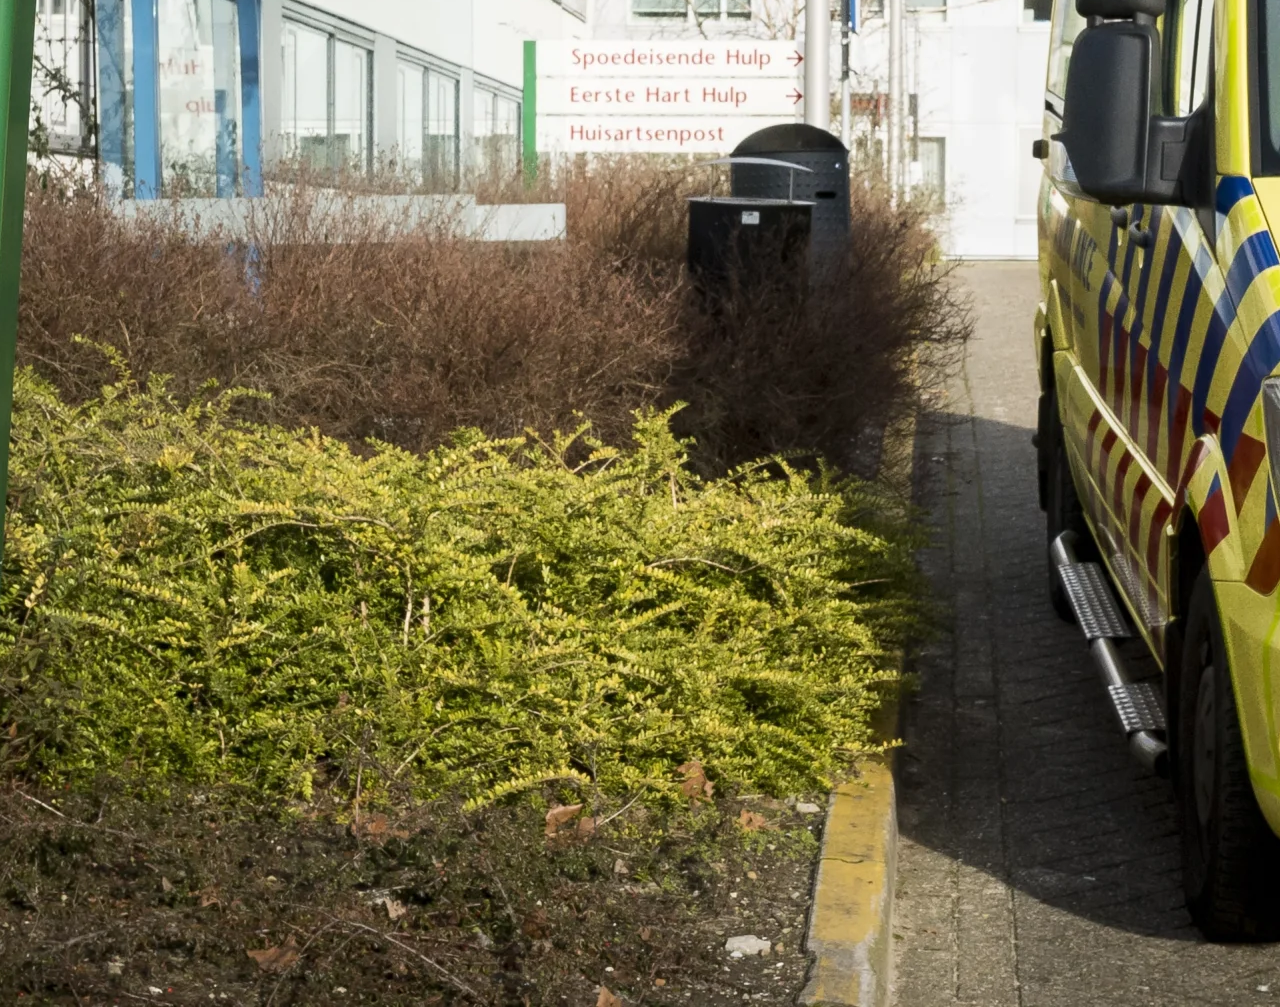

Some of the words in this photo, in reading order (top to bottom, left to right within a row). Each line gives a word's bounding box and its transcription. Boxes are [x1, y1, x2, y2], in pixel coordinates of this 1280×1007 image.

[571, 48, 716, 68] Spoedeisende
[726, 49, 771, 70] Hulp
[570, 87, 635, 104] Eerste
[645, 87, 691, 104] Hart
[702, 87, 747, 107] Hulp
[570, 125, 724, 146] Huisartsenpost
